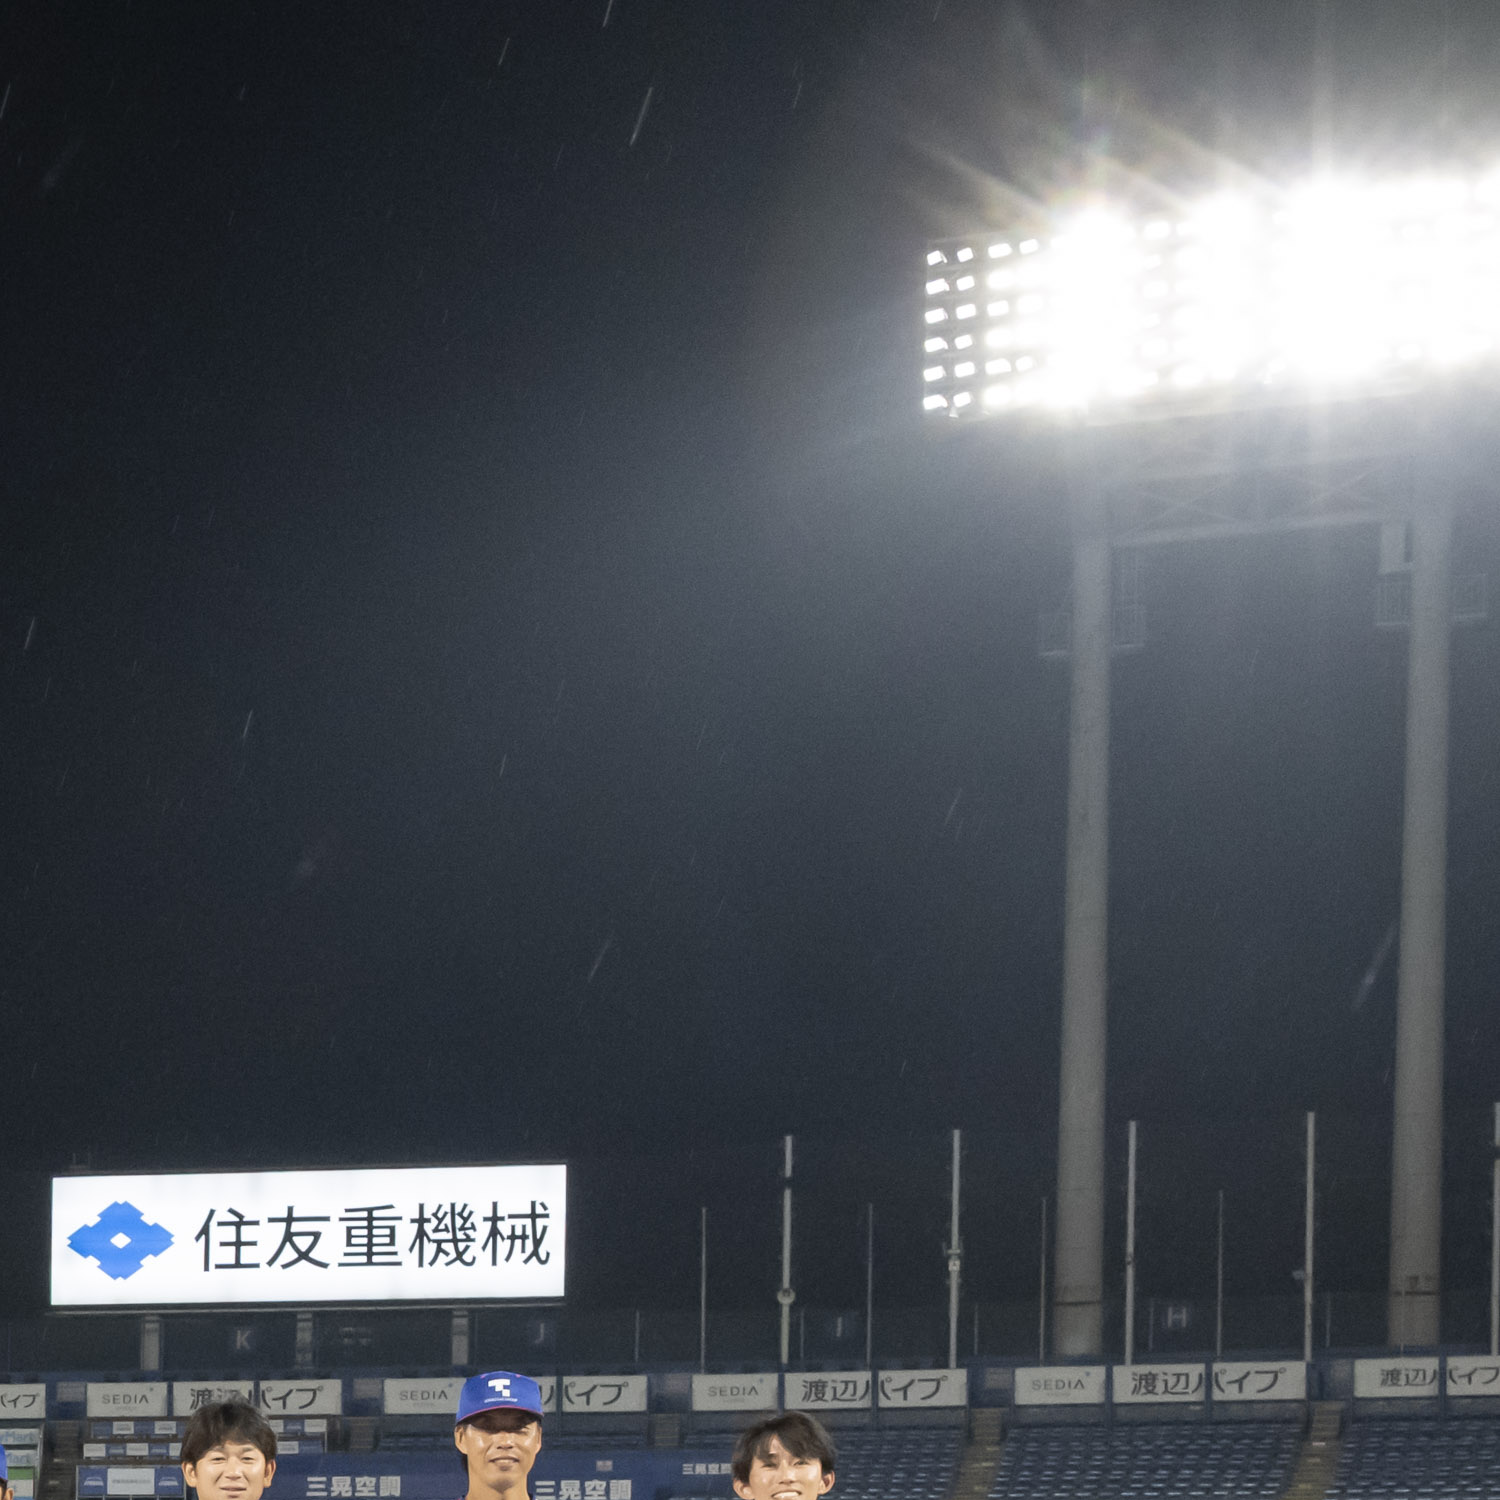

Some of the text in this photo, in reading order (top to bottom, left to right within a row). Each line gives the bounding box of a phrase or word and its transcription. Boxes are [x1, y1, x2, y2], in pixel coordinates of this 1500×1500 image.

[195, 1201, 550, 1271] 住友重機械
[802, 1376, 949, 1403] 渡辺パイプ
[1130, 1368, 1286, 1397] 渡辺パイプ
[307, 1476, 400, 1497] 三晃空調
[535, 1479, 632, 1500] 三晃空調
